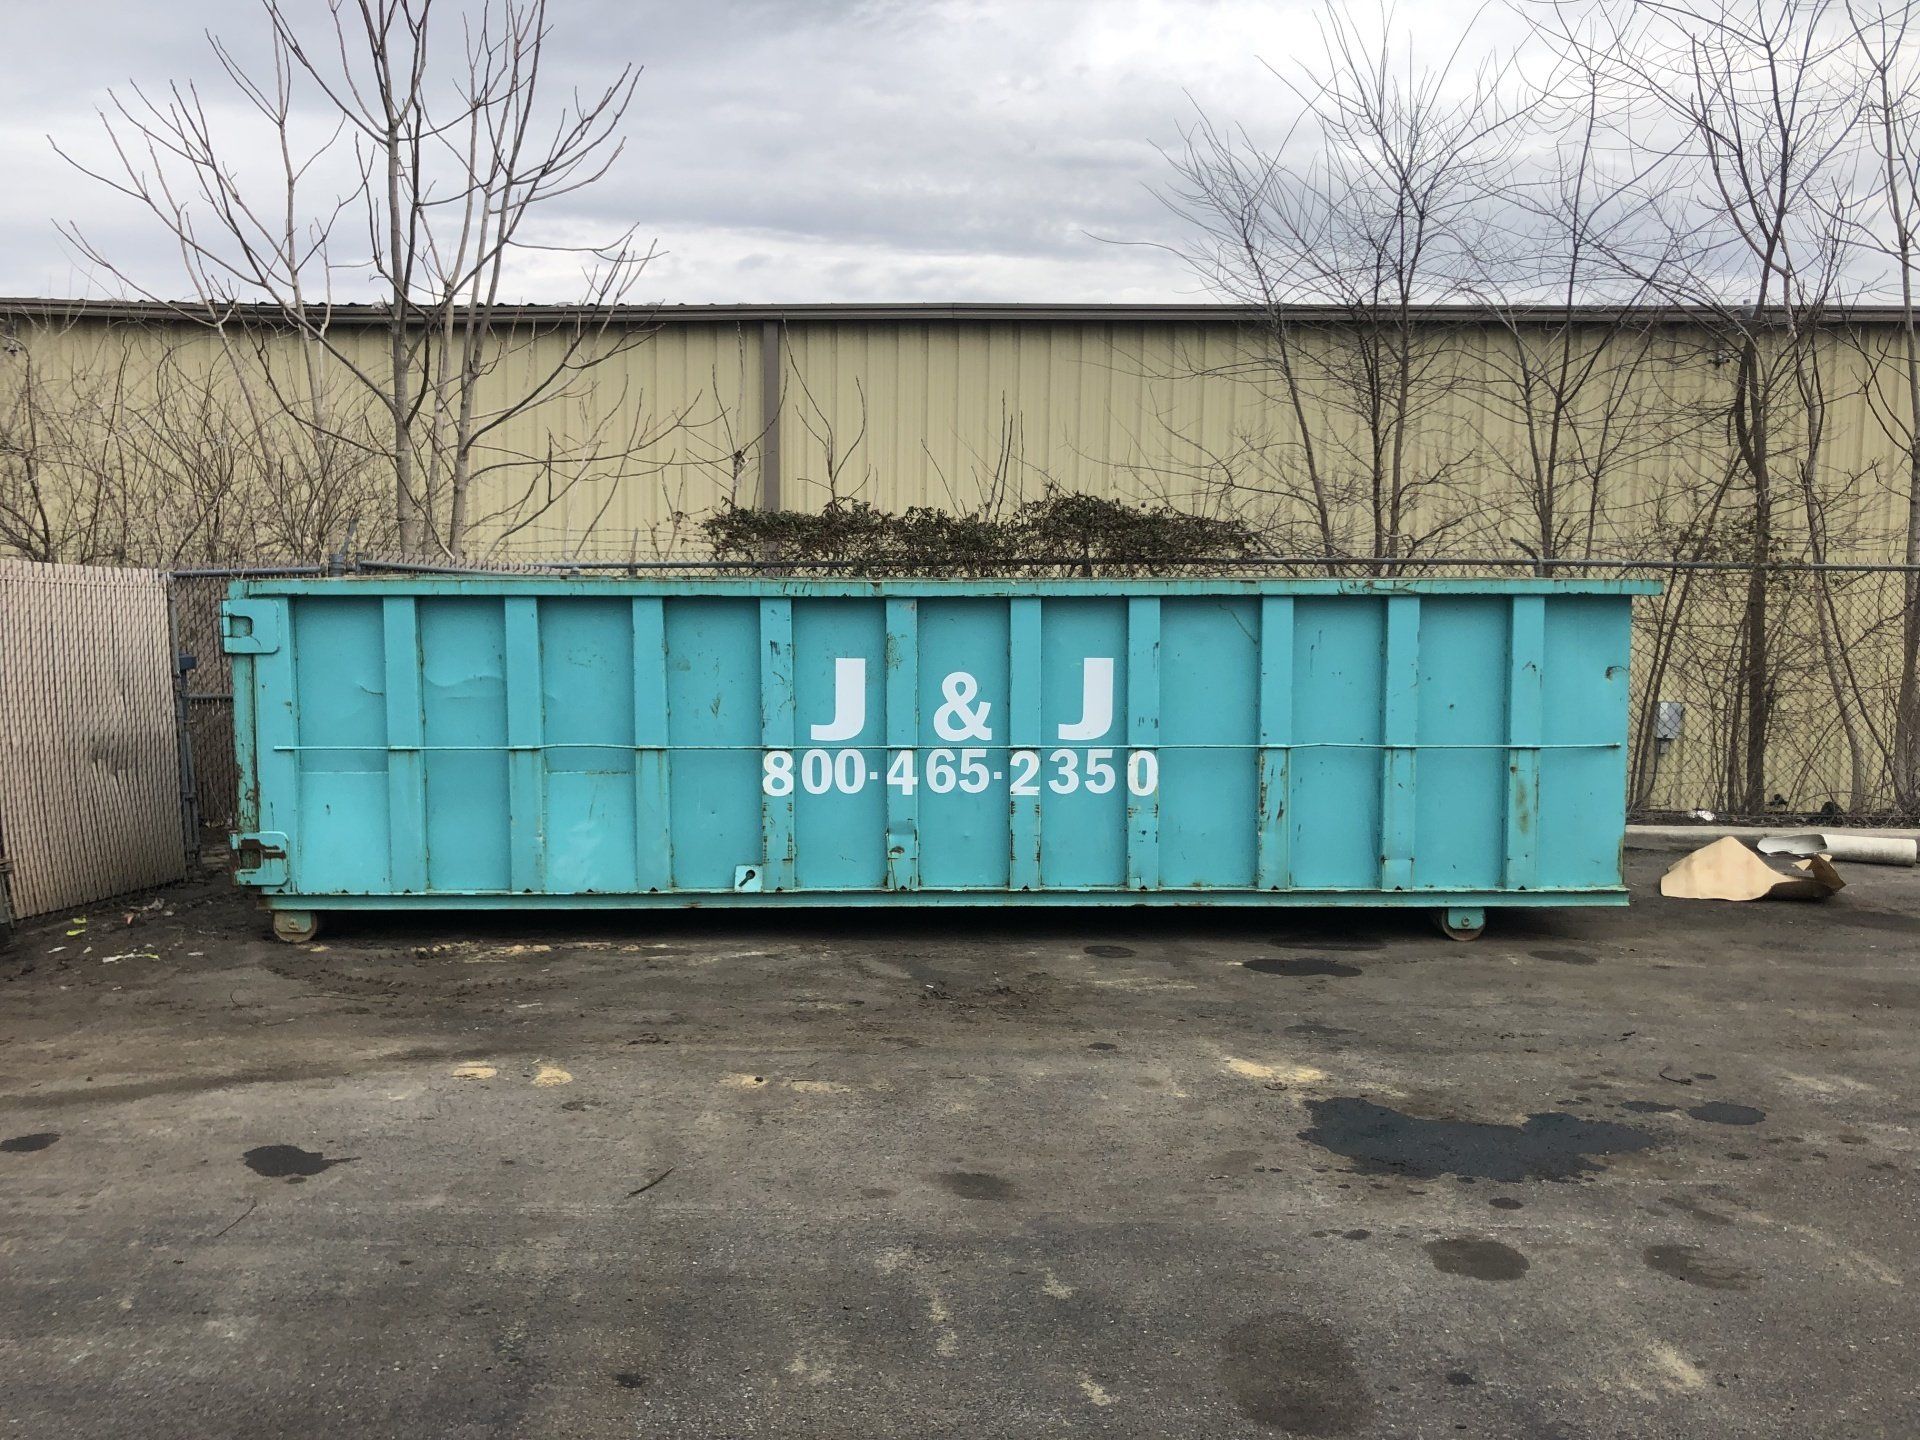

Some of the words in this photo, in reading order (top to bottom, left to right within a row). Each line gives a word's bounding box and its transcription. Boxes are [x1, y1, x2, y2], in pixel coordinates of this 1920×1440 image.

[810, 657, 866, 741] J
[933, 671, 992, 742] &
[1058, 657, 1114, 741] J
